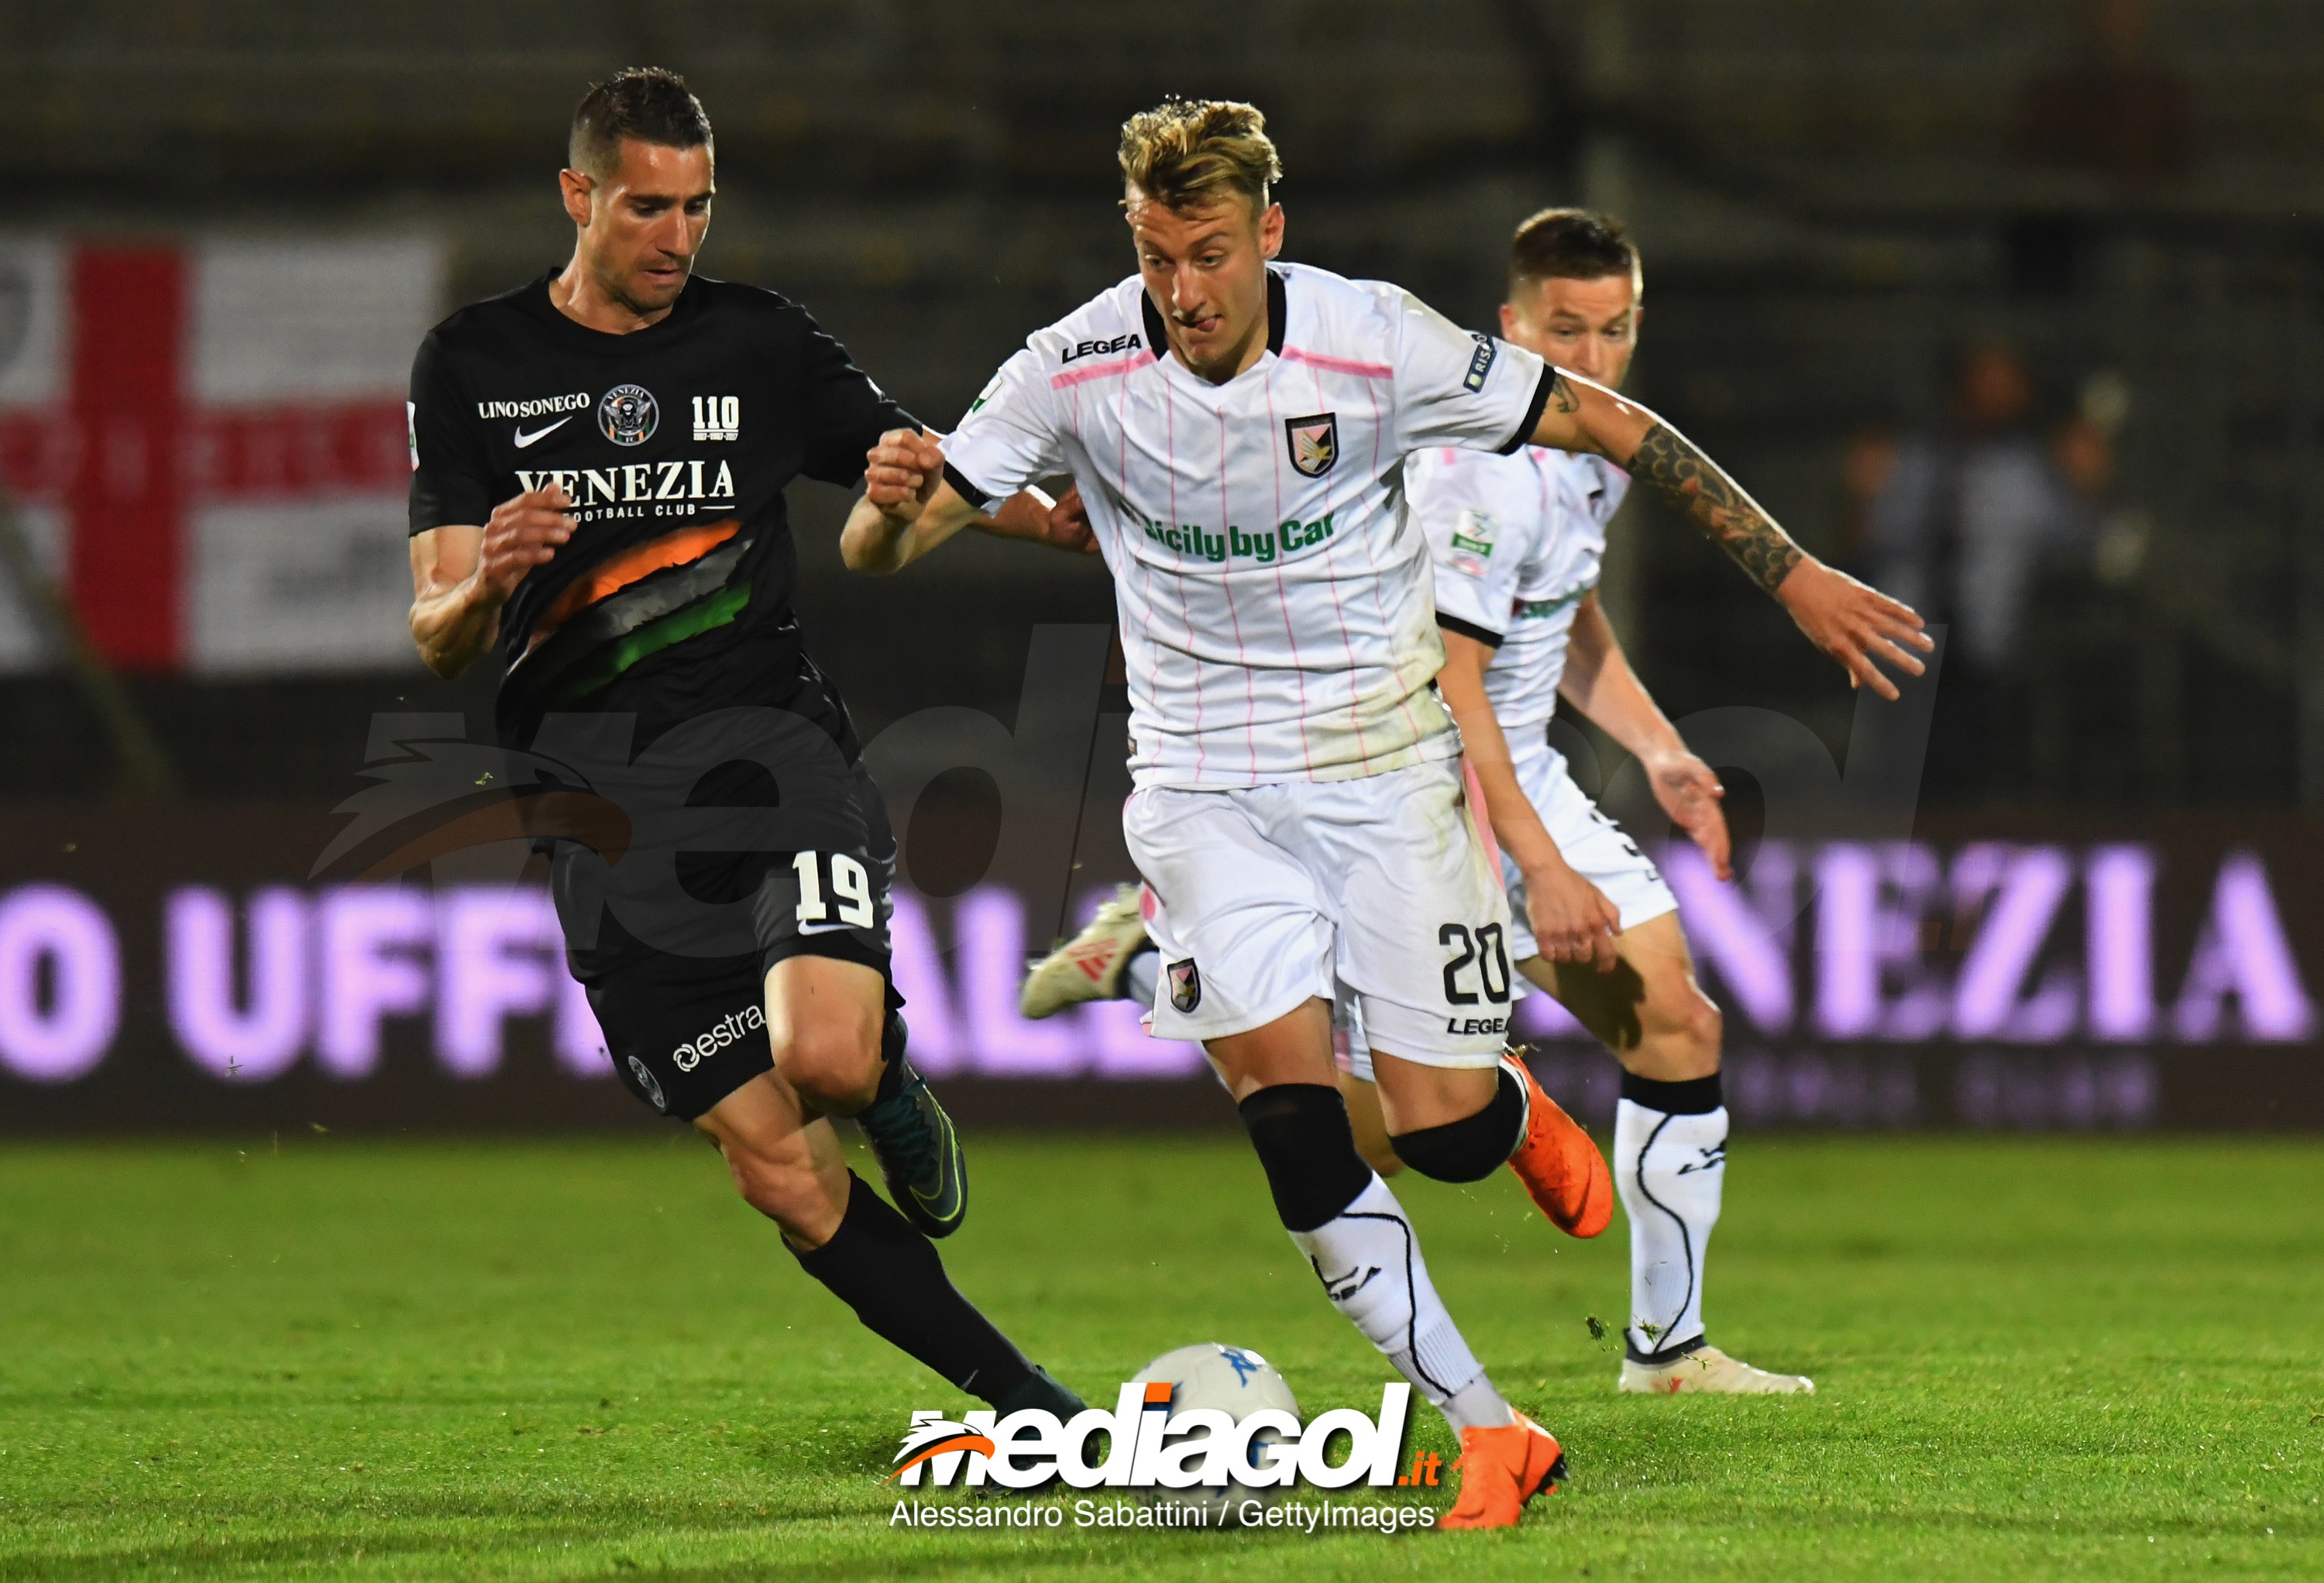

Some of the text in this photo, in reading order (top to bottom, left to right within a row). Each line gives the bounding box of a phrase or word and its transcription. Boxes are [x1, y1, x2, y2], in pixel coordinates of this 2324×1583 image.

[1062, 334, 1142, 364] LEGEA
[693, 396, 739, 429] 110
[514, 459, 735, 507] VENEZIA
[562, 504, 696, 523] OOTBALL CLUB
[1229, 526, 1276, 562] by
[1280, 511, 1335, 552] Car
[792, 850, 874, 929] 19
[1439, 922, 1510, 1005] 20
[696, 1005, 766, 1056] estra
